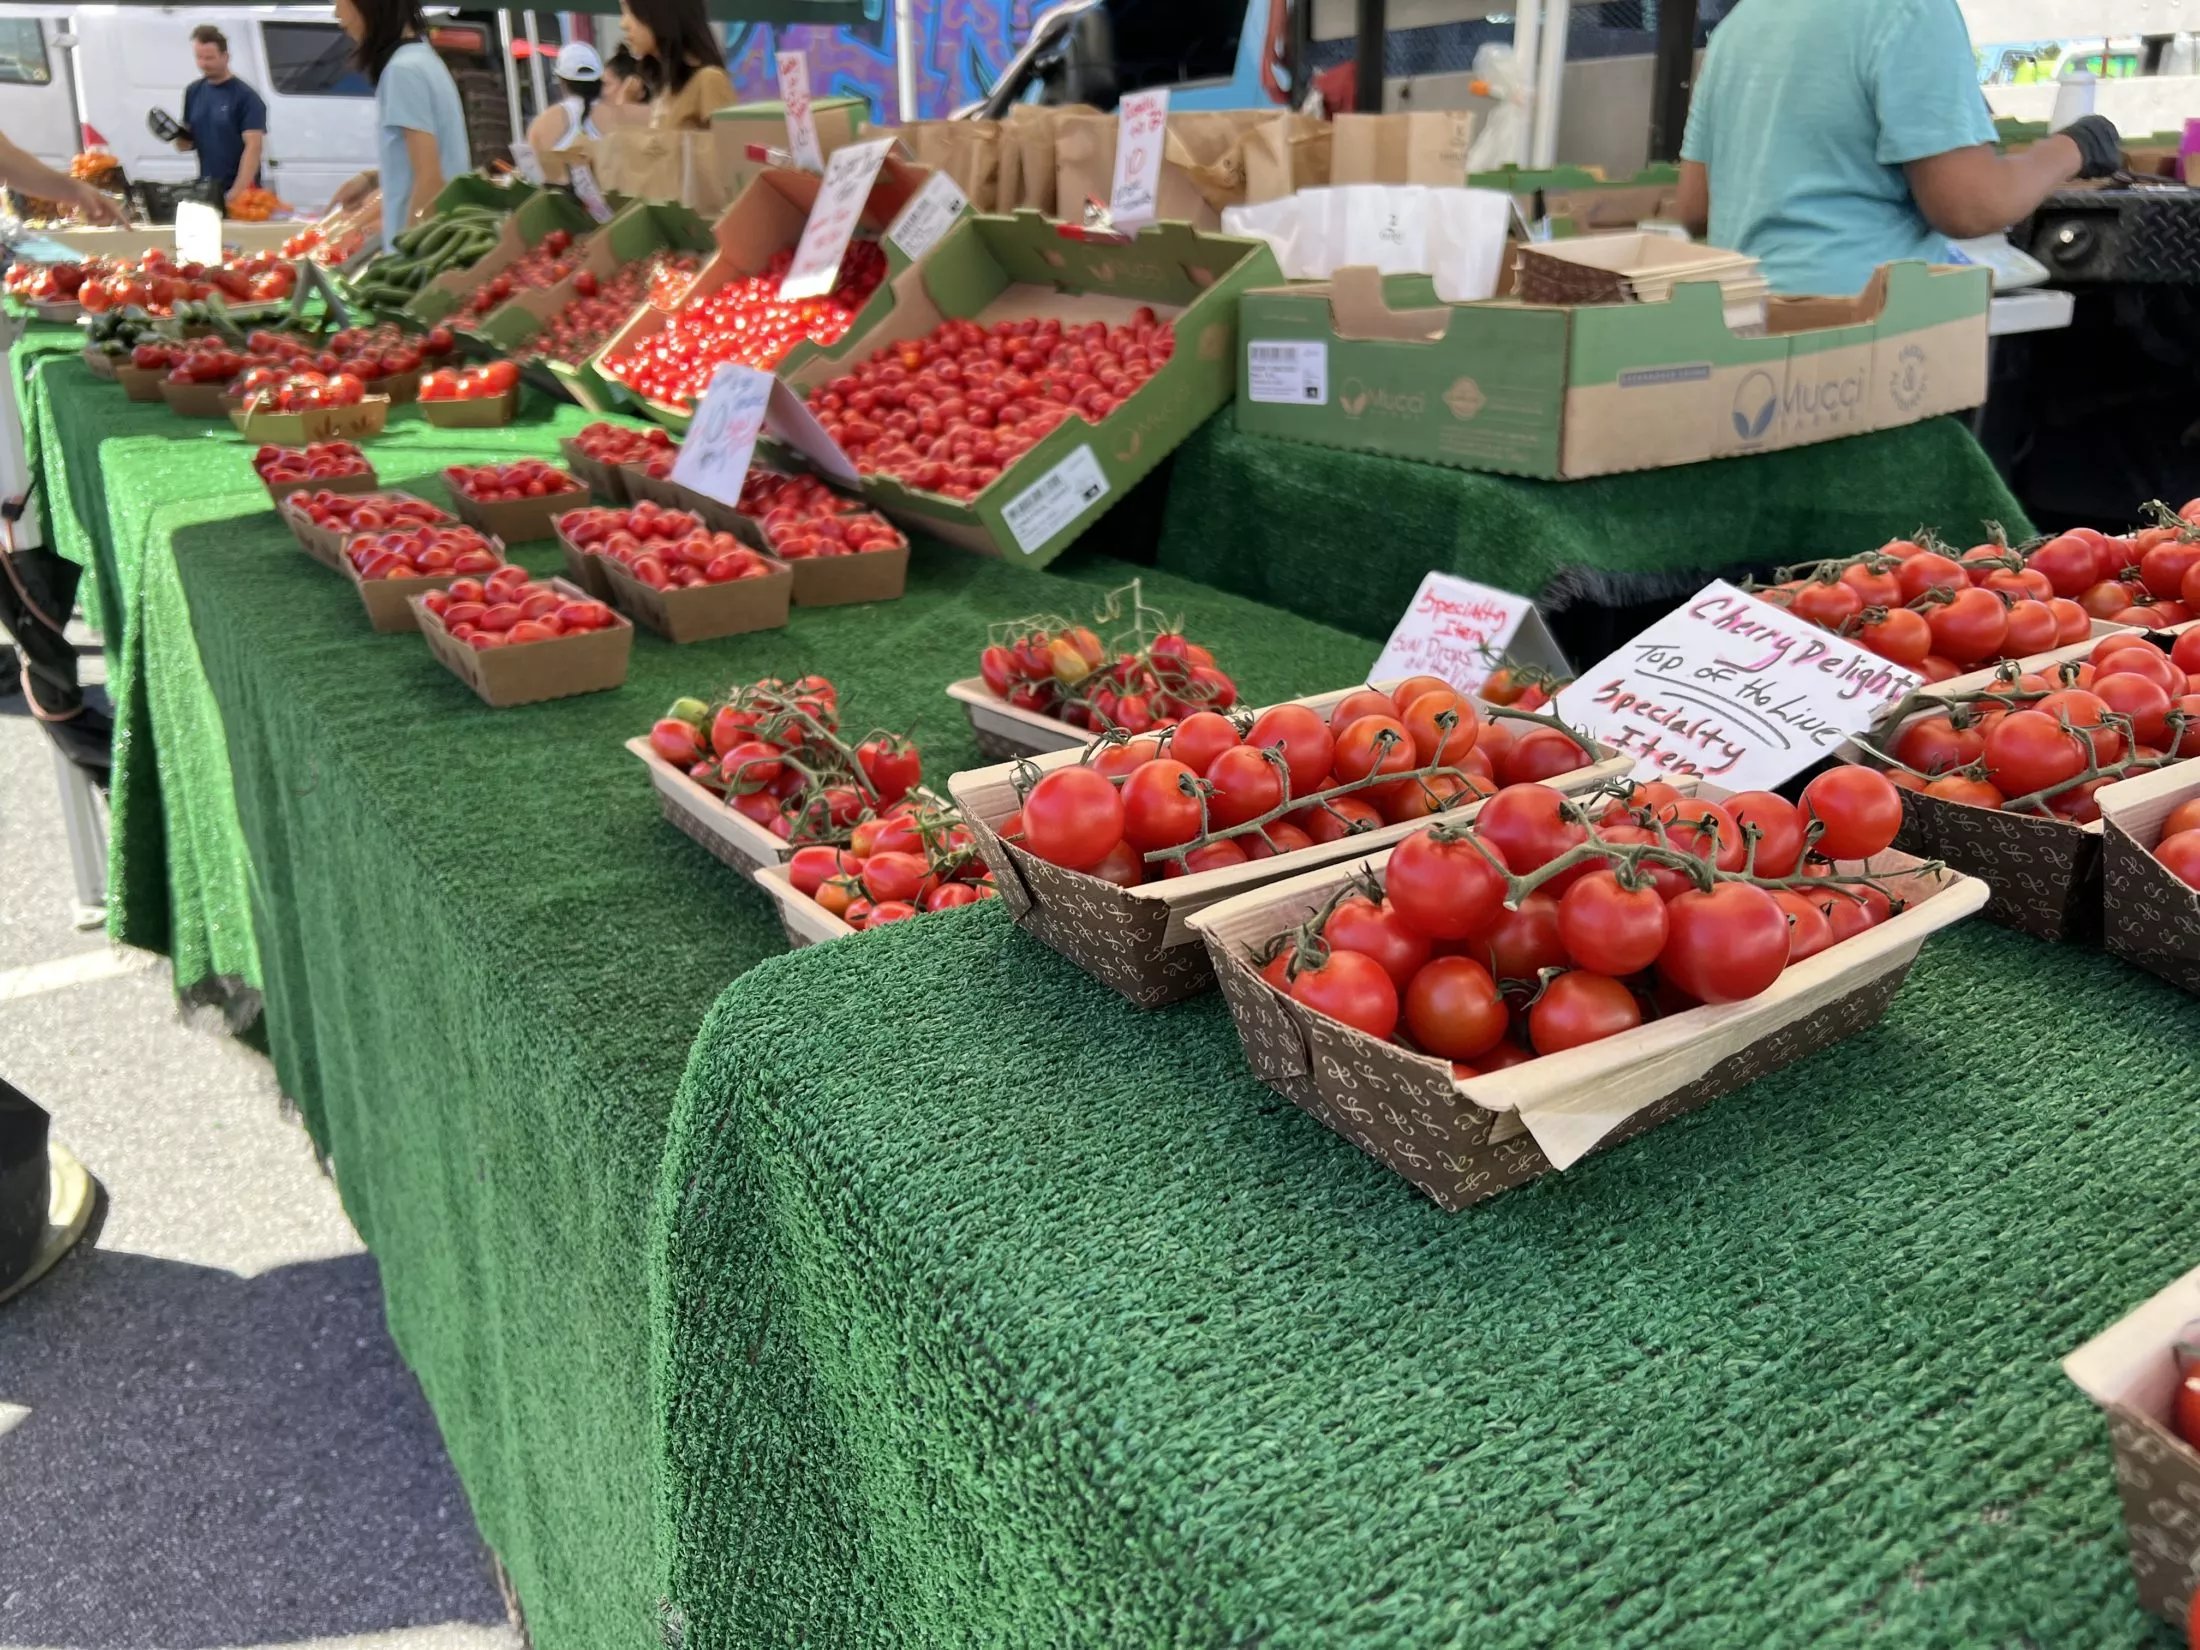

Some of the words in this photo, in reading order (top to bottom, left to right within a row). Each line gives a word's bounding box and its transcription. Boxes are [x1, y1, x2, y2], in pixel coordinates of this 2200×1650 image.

[1689, 595, 1797, 674] Cherry
[1788, 639, 1914, 701] Delight
[1591, 678, 1747, 777] Specialty
[1602, 724, 1705, 782] Item
